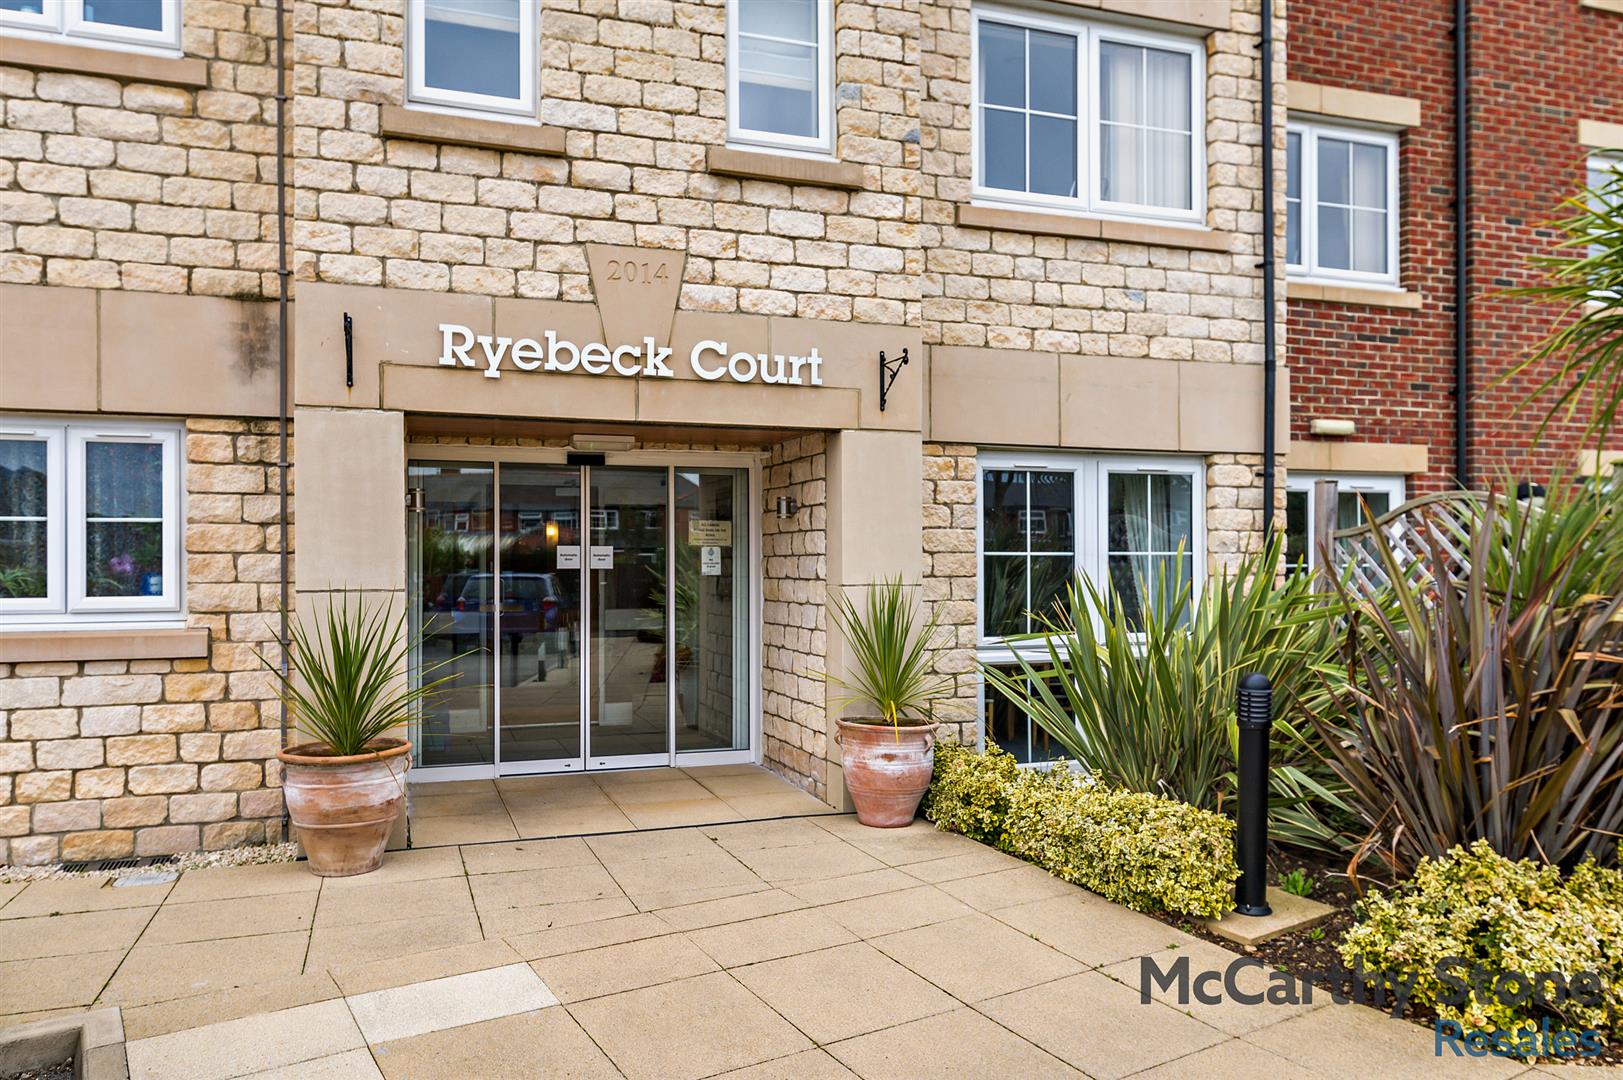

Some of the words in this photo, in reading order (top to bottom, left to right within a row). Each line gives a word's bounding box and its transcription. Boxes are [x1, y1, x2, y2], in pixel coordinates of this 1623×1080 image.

[607, 259, 669, 285] 2014
[438, 323, 674, 378] Ryebeck
[690, 340, 824, 386] Court
